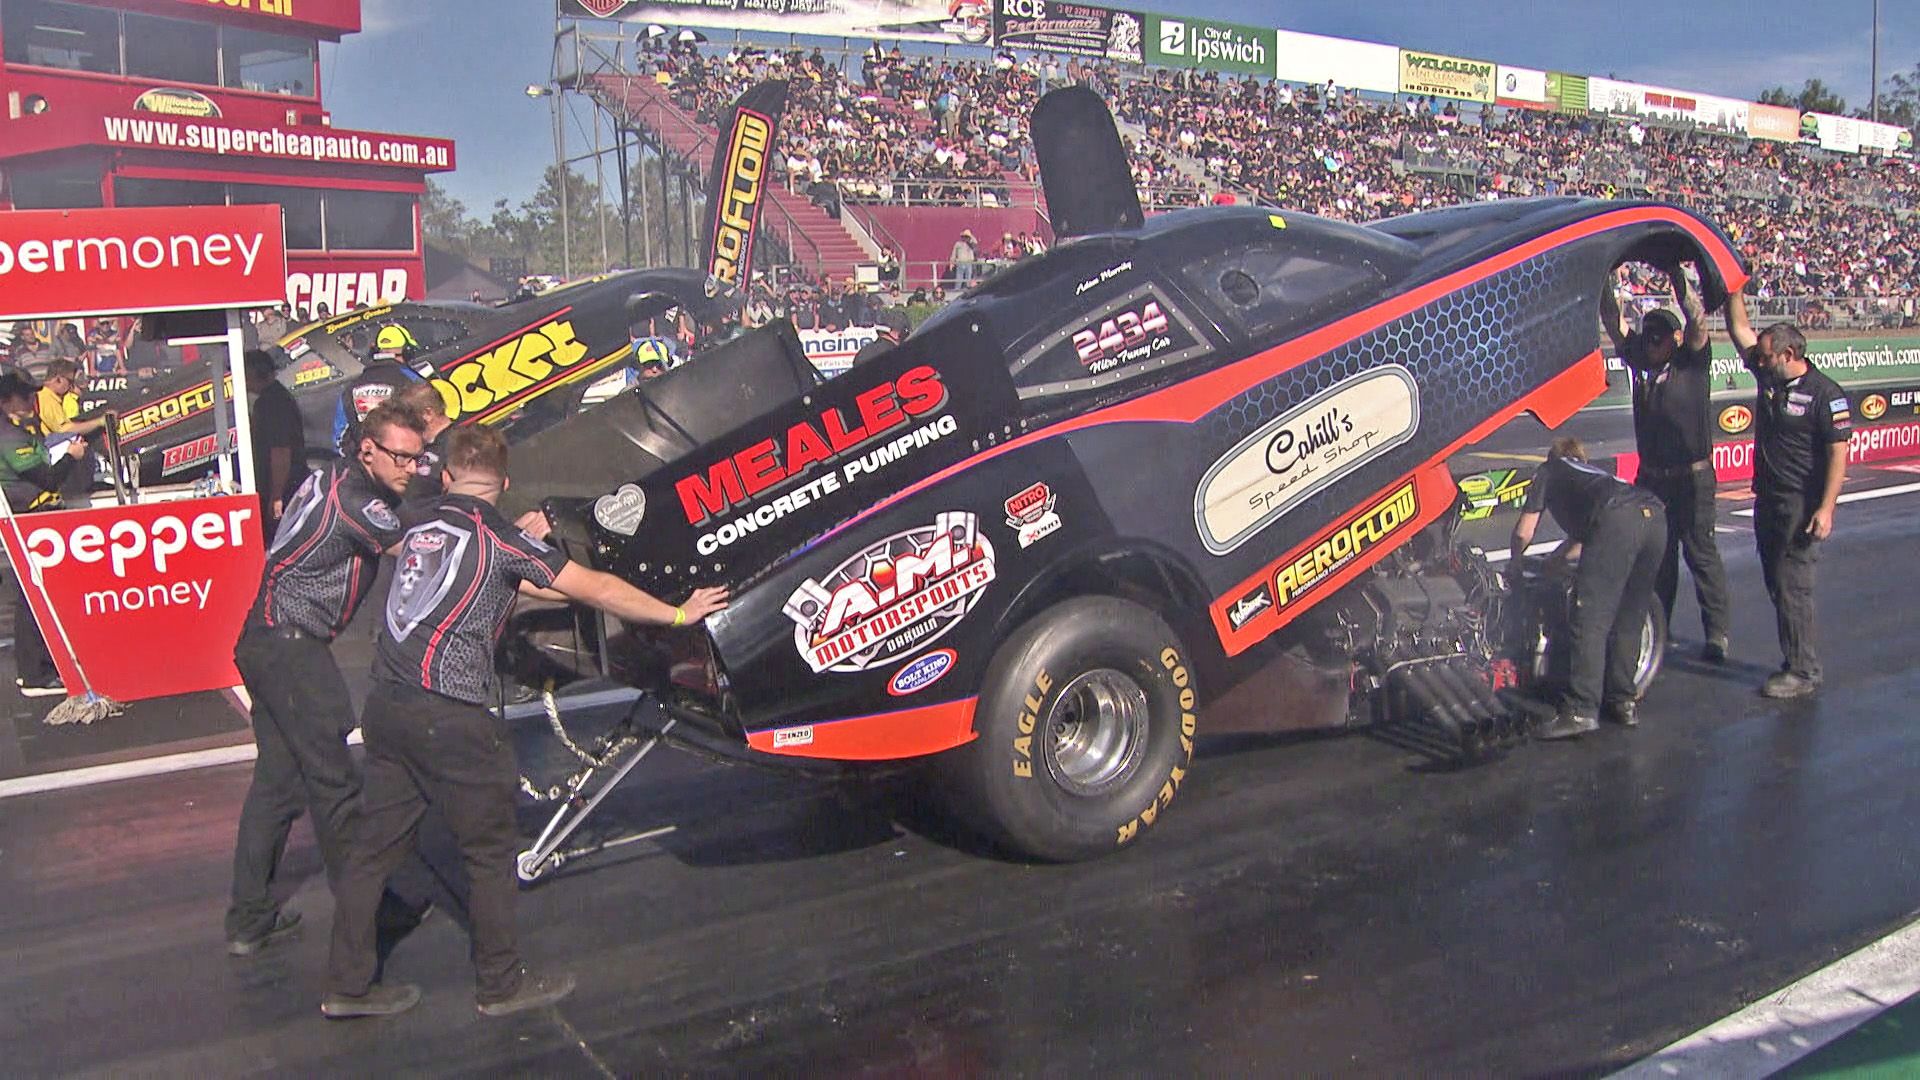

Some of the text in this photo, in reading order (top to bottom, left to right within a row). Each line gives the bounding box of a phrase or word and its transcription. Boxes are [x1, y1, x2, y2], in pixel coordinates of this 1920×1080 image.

[1002, 0, 1046, 19] RCE
[1191, 27, 1265, 65] Ipswich
[1204, 27, 1232, 40] City of
[1405, 53, 1491, 77] WILCLEAN
[713, 113, 769, 286] ROFLOW
[287, 269, 407, 321] CHEAP
[1075, 277, 1100, 296] Adam
[1072, 301, 1169, 366] 2434
[1089, 336, 1171, 374] Nitro Funny Car
[1607, 357, 1625, 371] OIL
[1806, 345, 1920, 371] scoverIpswich.com
[1891, 391, 1913, 406] GULF
[675, 364, 950, 529] MEALES
[1264, 407, 1354, 474] Cahill's
[696, 470, 842, 556] CONCRETE
[843, 414, 958, 484] PUMPING
[1248, 429, 1379, 510] Speed Shop
[1009, 486, 1045, 513] NITRO
[27, 508, 252, 587] pepper
[1276, 482, 1416, 606] AEROFLOW
[84, 578, 213, 616] money
[815, 562, 990, 667] MOTORSPORTS
[886, 617, 940, 653] DARWIN
[896, 655, 948, 689] BOLT KING
[1013, 668, 1054, 779] EAGLE
